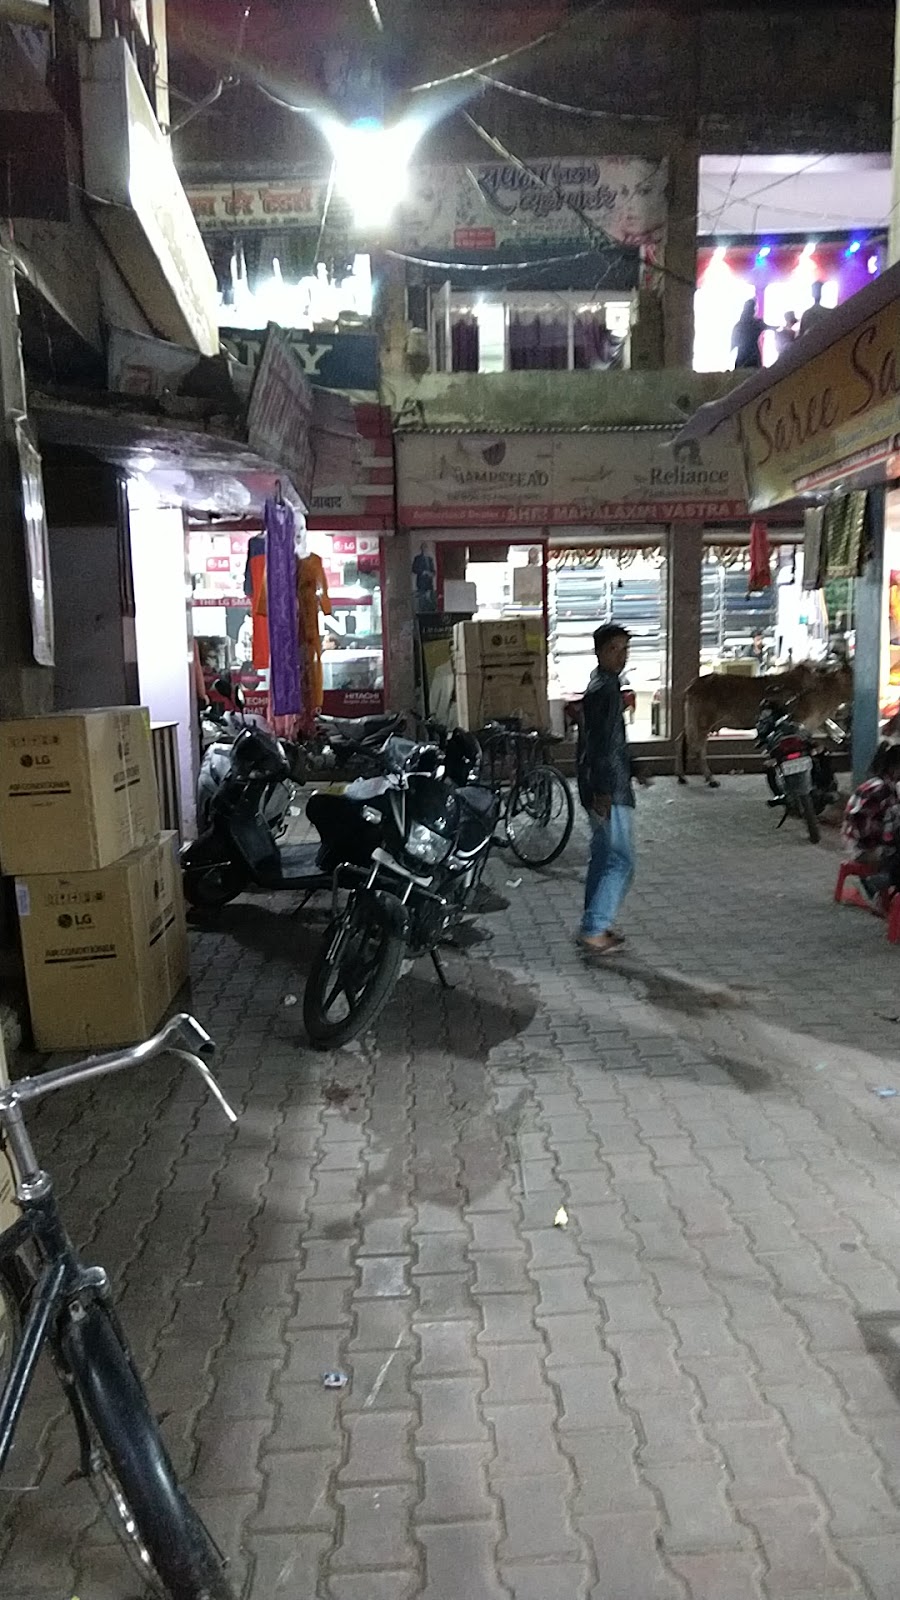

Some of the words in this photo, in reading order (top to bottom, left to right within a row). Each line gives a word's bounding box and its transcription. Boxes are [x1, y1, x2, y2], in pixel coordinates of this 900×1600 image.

[755, 387, 840, 465] Saree
[650, 466, 729, 485] Reliance
[663, 502, 730, 518] VASTRA
